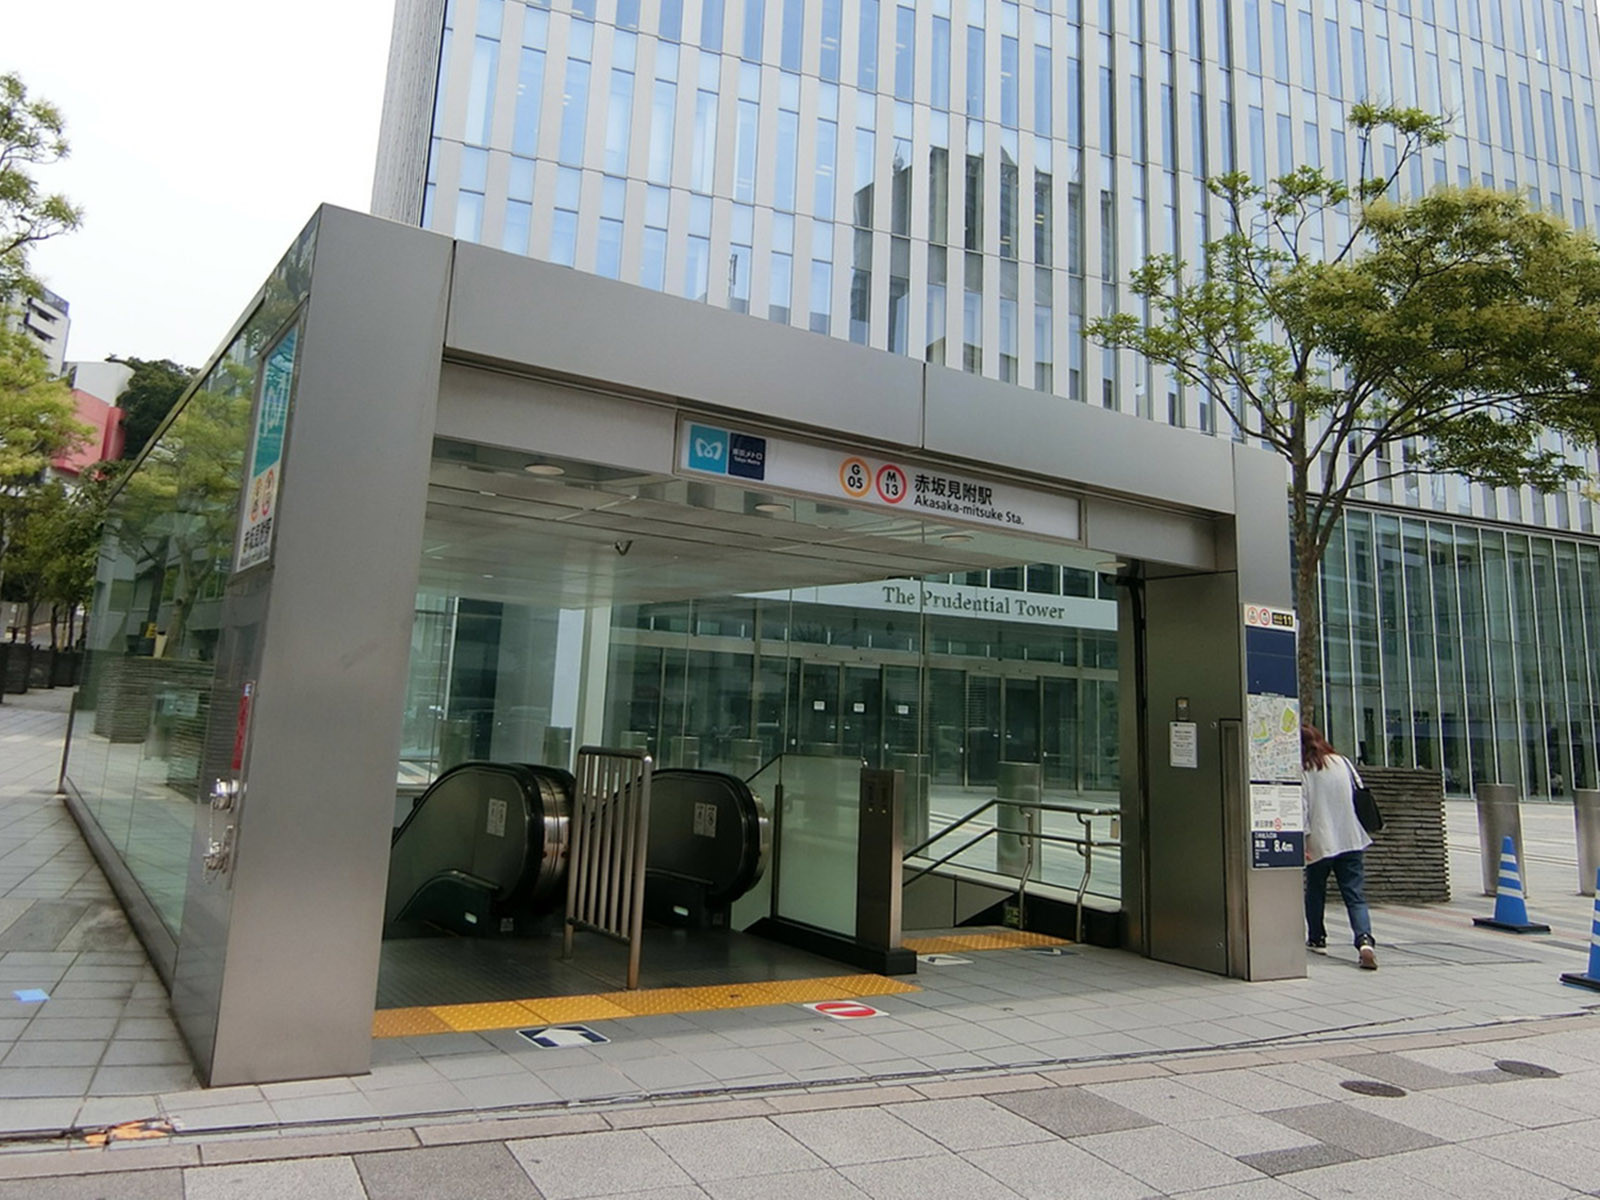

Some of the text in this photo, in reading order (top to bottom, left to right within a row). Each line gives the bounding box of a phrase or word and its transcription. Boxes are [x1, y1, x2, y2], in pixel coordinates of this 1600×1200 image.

[851, 464, 860, 475] G
[847, 476, 863, 489] 05
[886, 472, 897, 483] M
[884, 483, 899, 496] 13
[914, 474, 993, 506] 赤坂見附駅
[914, 495, 1025, 525] Akasaka-mitsuke Sta.
[882, 586, 1066, 619] The Prudential Tower
